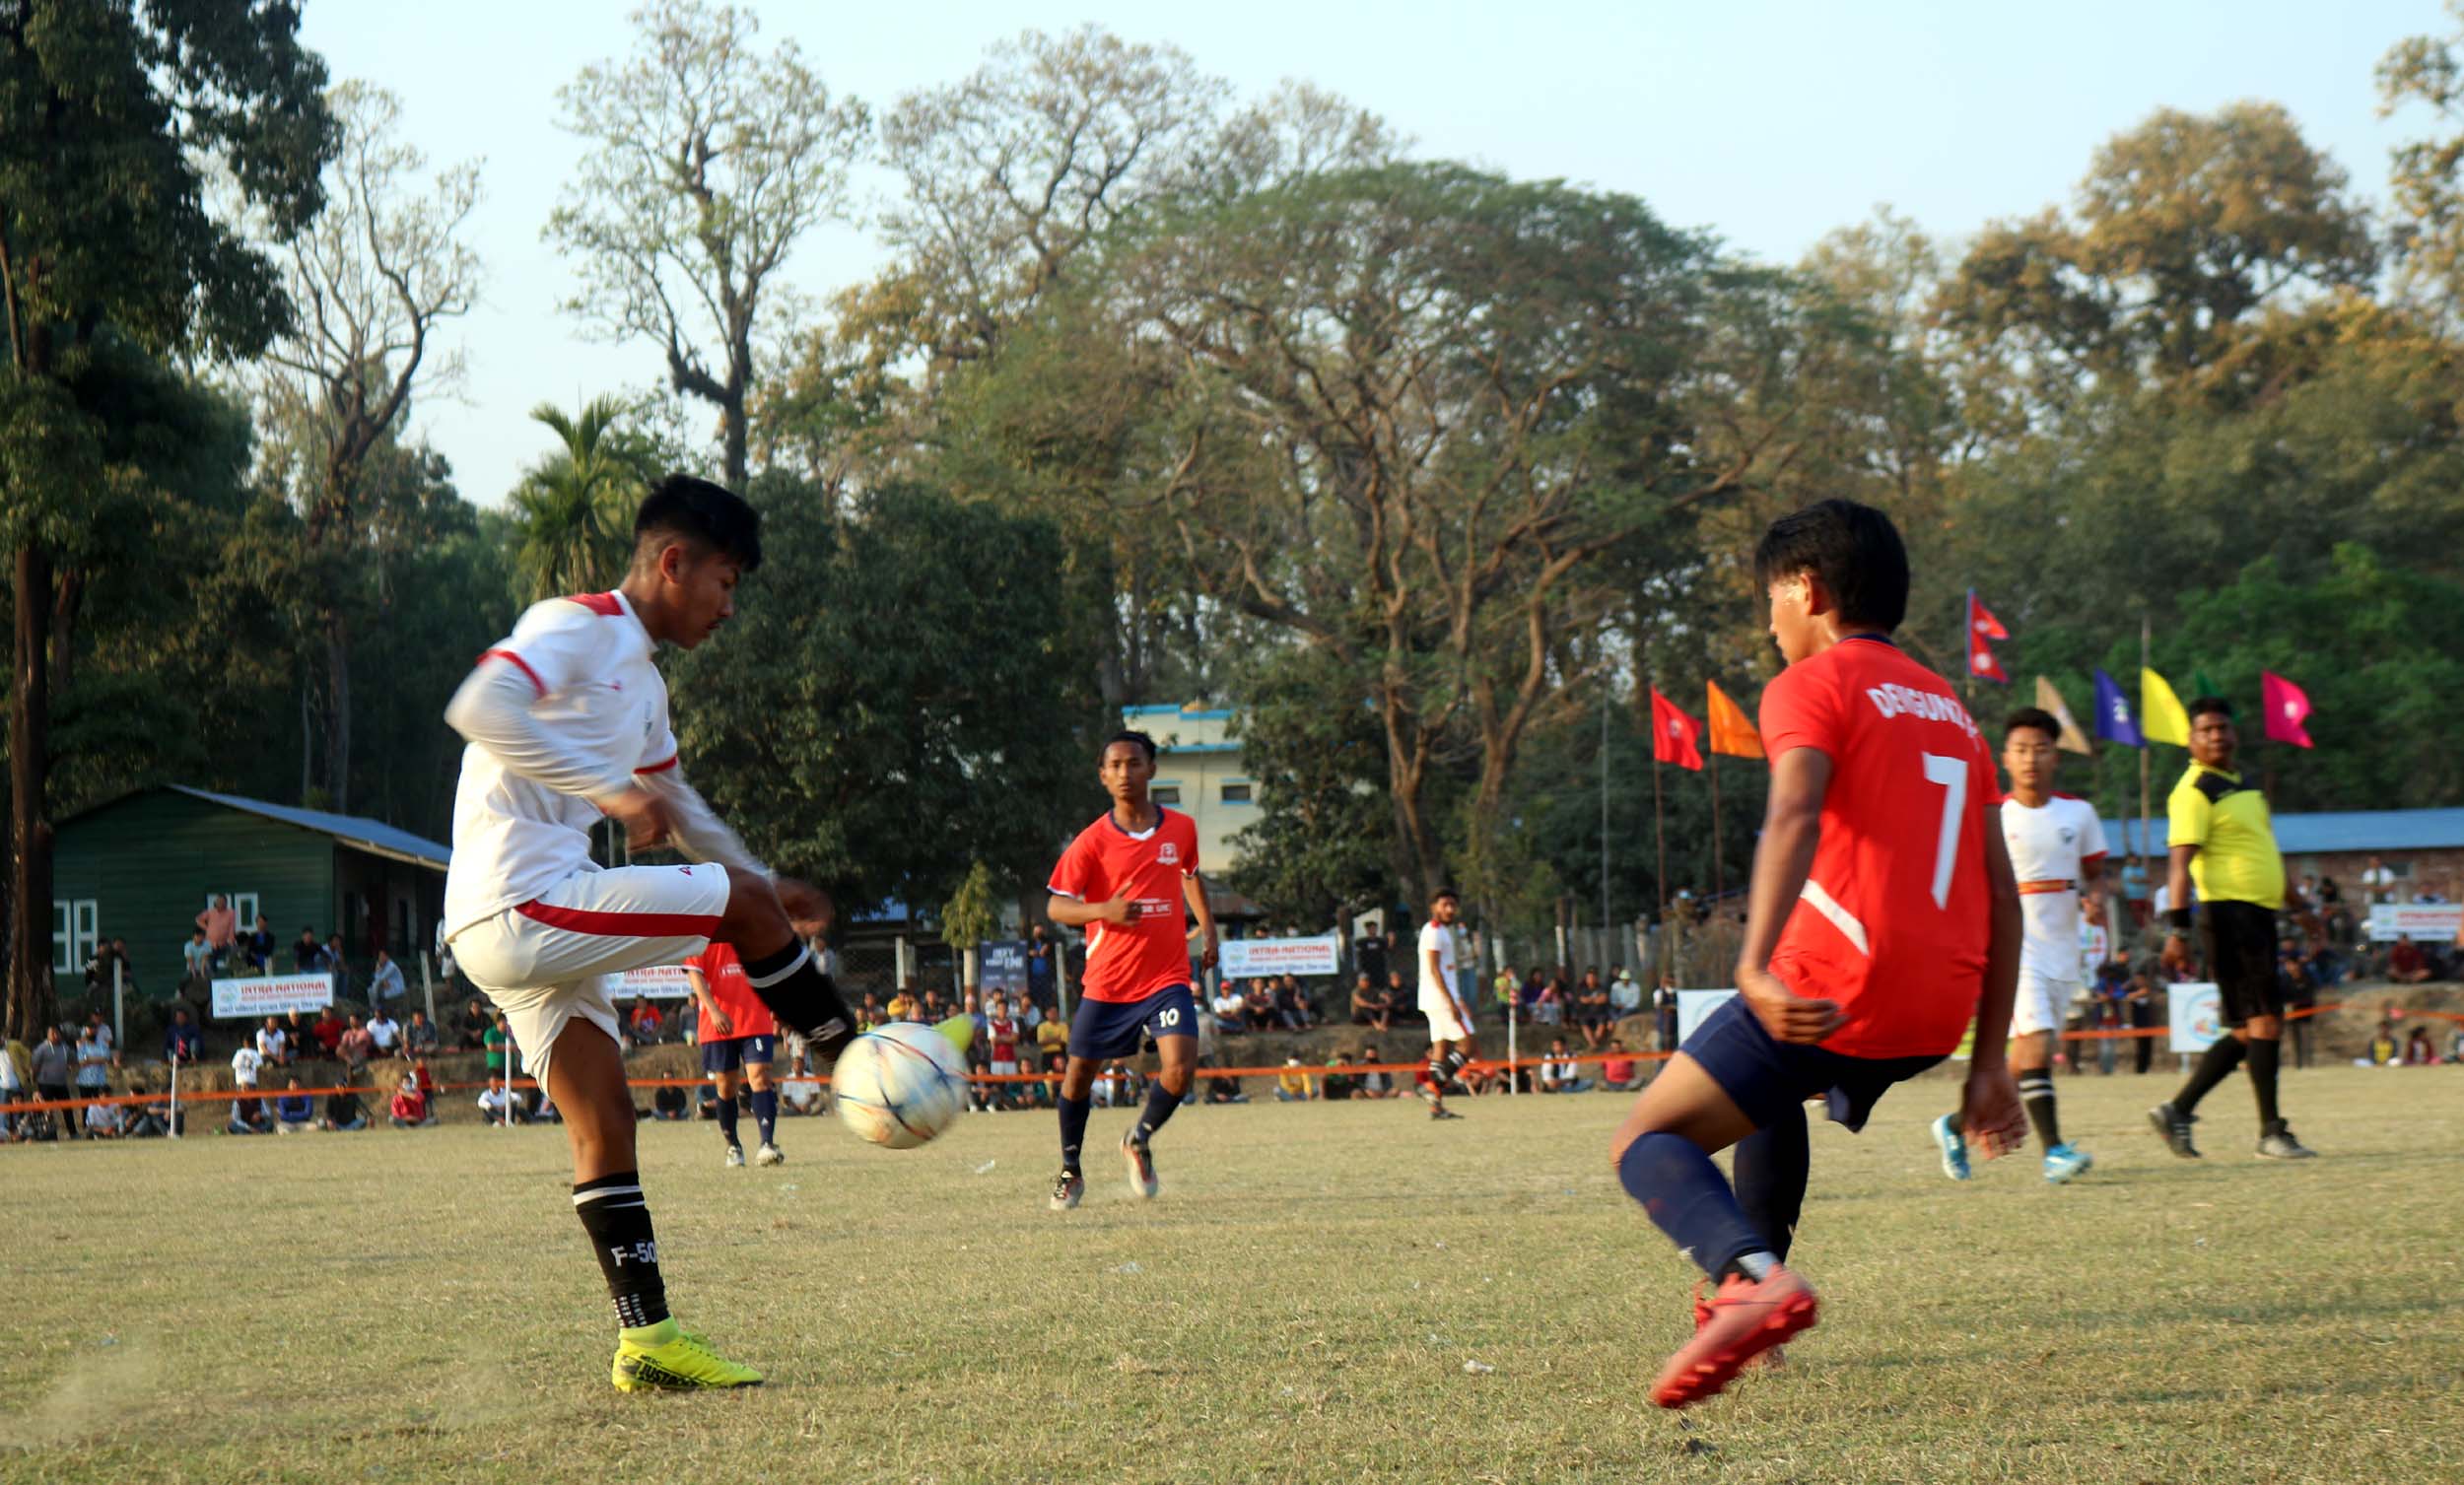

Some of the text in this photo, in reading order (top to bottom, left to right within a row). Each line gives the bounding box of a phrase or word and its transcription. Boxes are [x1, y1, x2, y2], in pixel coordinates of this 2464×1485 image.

[1922, 750, 1968, 911] 7
[1159, 1007, 1180, 1028] 10
[610, 1241, 657, 1267] F-50
